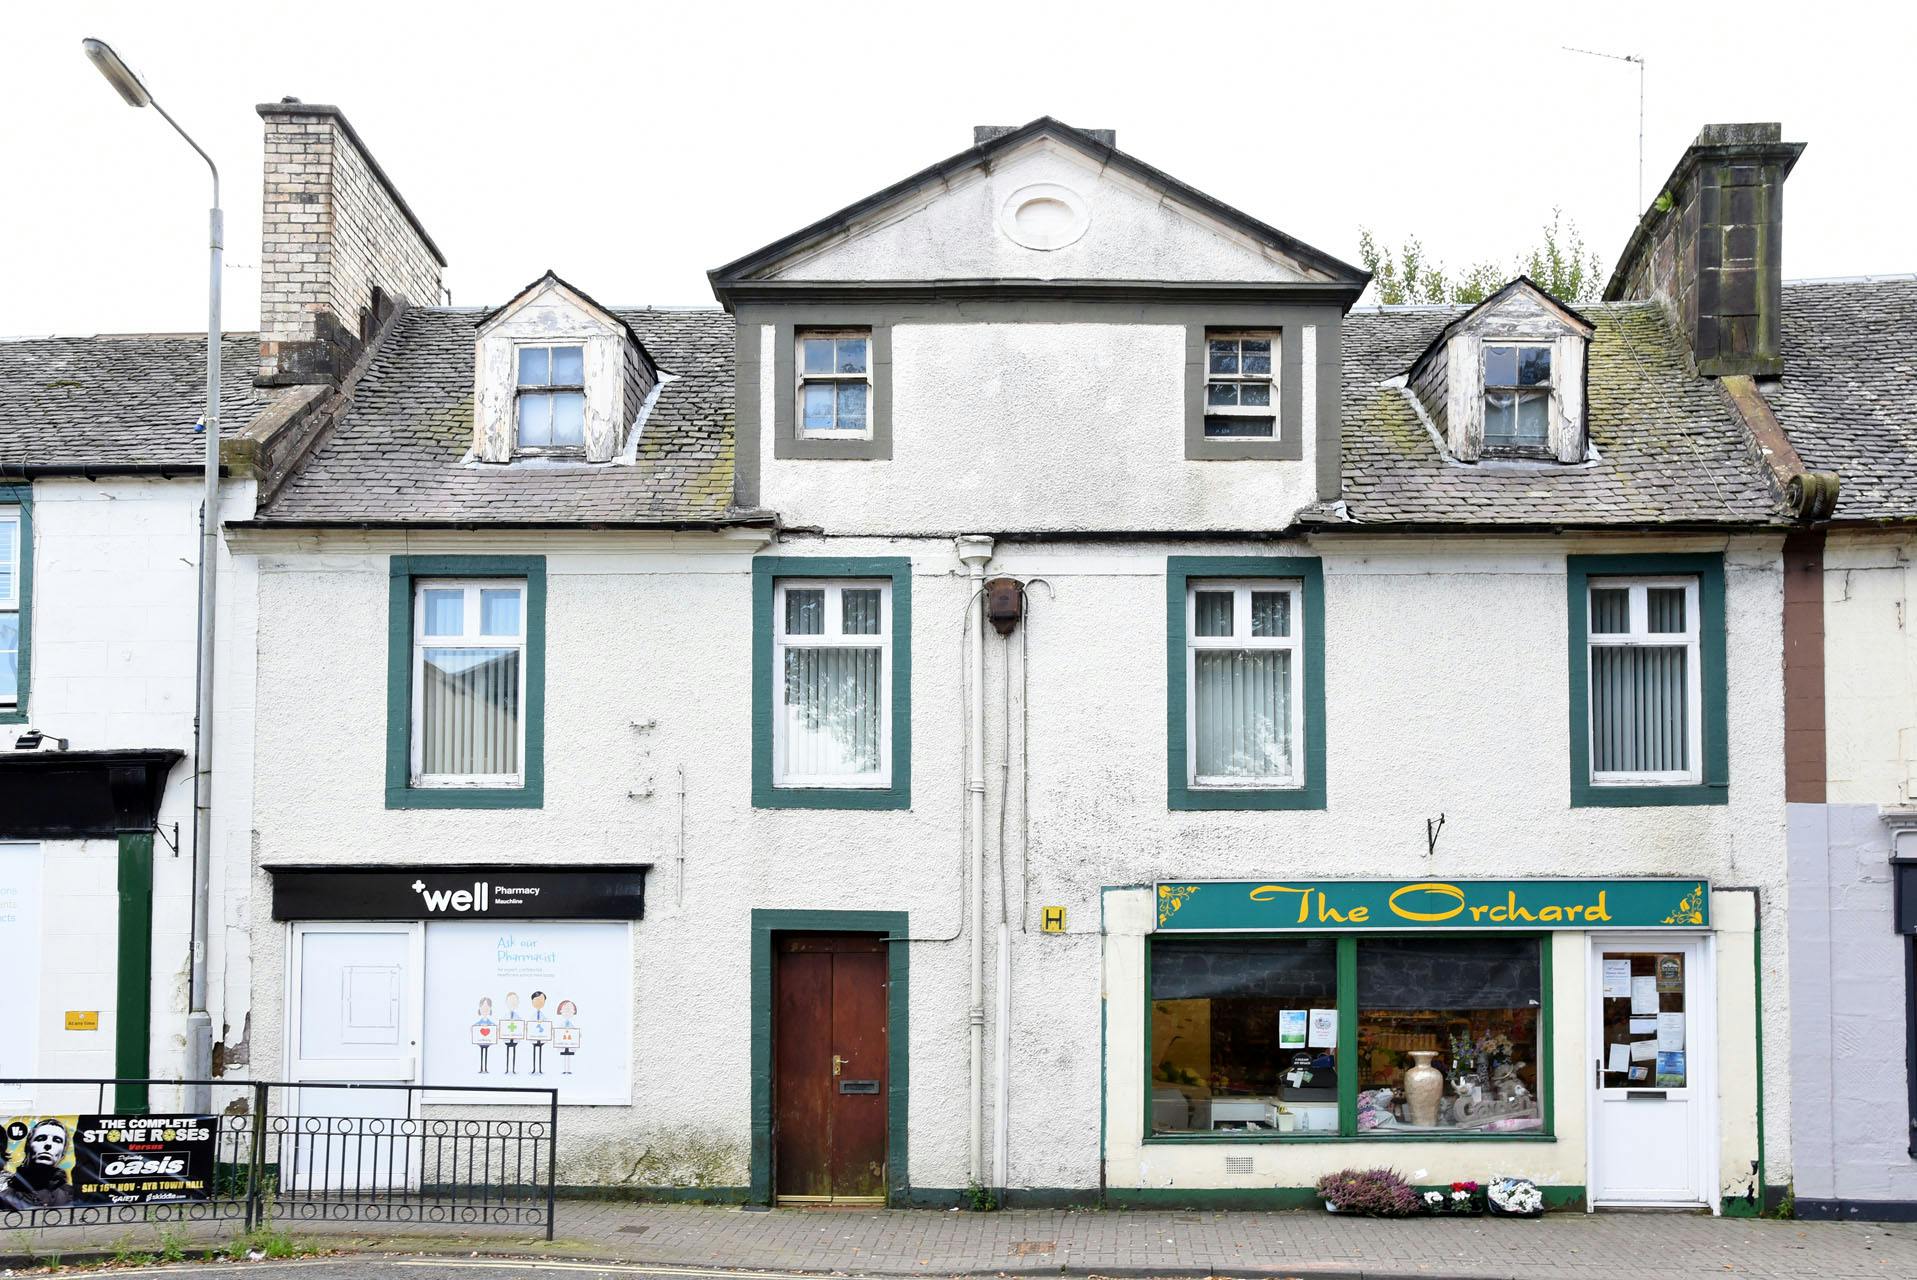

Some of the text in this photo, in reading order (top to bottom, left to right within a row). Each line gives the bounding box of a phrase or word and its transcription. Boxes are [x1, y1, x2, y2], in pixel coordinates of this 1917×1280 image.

[422, 882, 488, 912] well
[495, 886, 540, 896] Pharmacy
[1250, 883, 1612, 923] The Orchard
[1046, 909, 1062, 930] H
[497, 935, 538, 949] Ask our
[497, 949, 557, 964] Pharmacist
[99, 1118, 197, 1129] THE COMPLETE
[83, 1127, 210, 1143] STONE ROSES
[105, 1156, 185, 1175] oasis
[81, 1184, 98, 1193] SAT
[117, 1182, 136, 1191] NOV
[142, 1182, 158, 1190] AYR
[159, 1181, 185, 1190] TOWN
[185, 1180, 204, 1189] HALL
[112, 1195, 140, 1203] GAIETY
